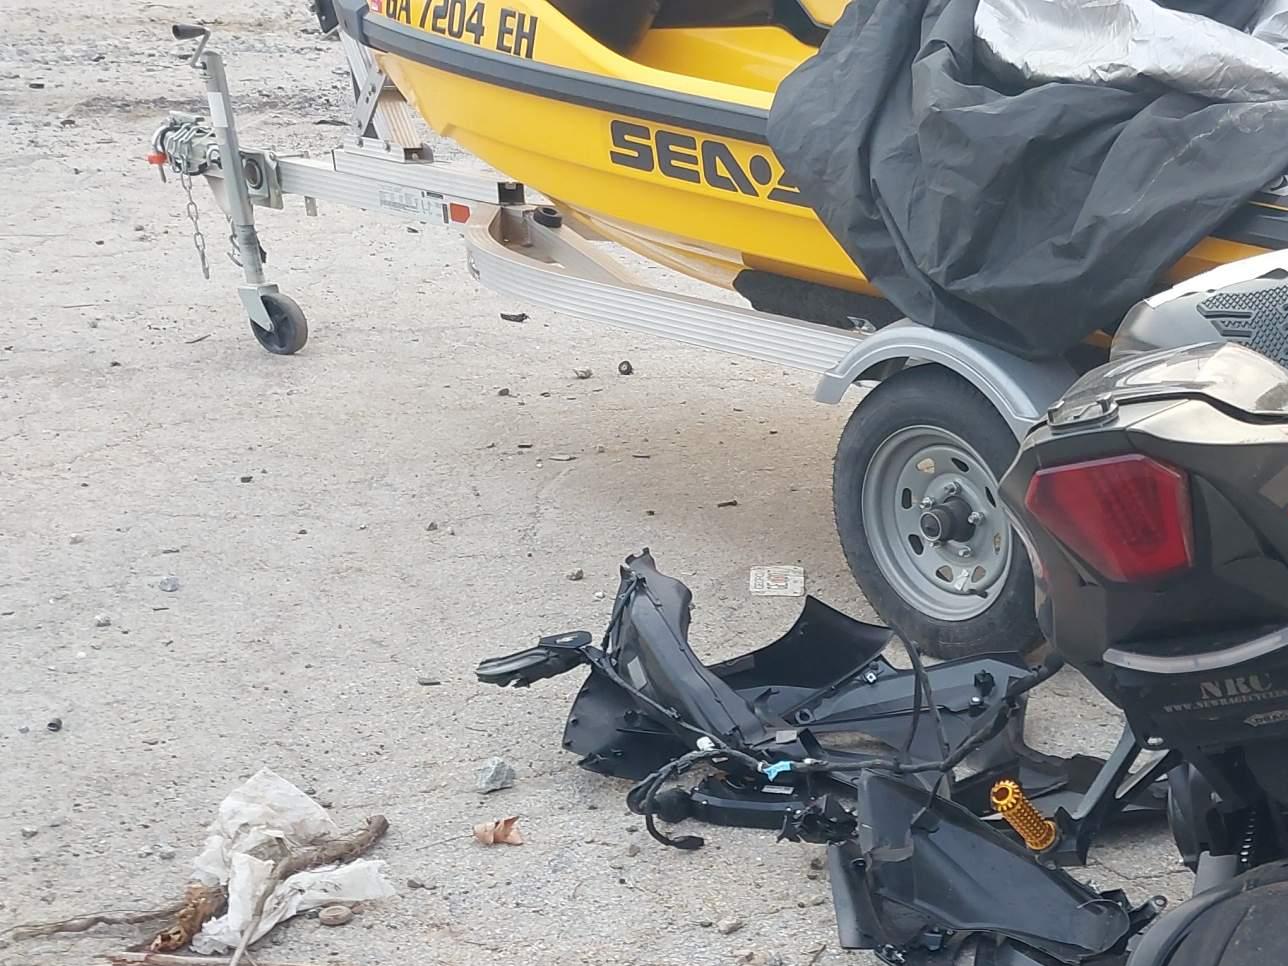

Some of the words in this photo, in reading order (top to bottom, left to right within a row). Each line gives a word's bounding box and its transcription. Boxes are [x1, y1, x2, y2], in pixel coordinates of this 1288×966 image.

[420, 0, 485, 45] 7204
[496, 8, 538, 58] EH
[1200, 673, 1272, 699] NRC
